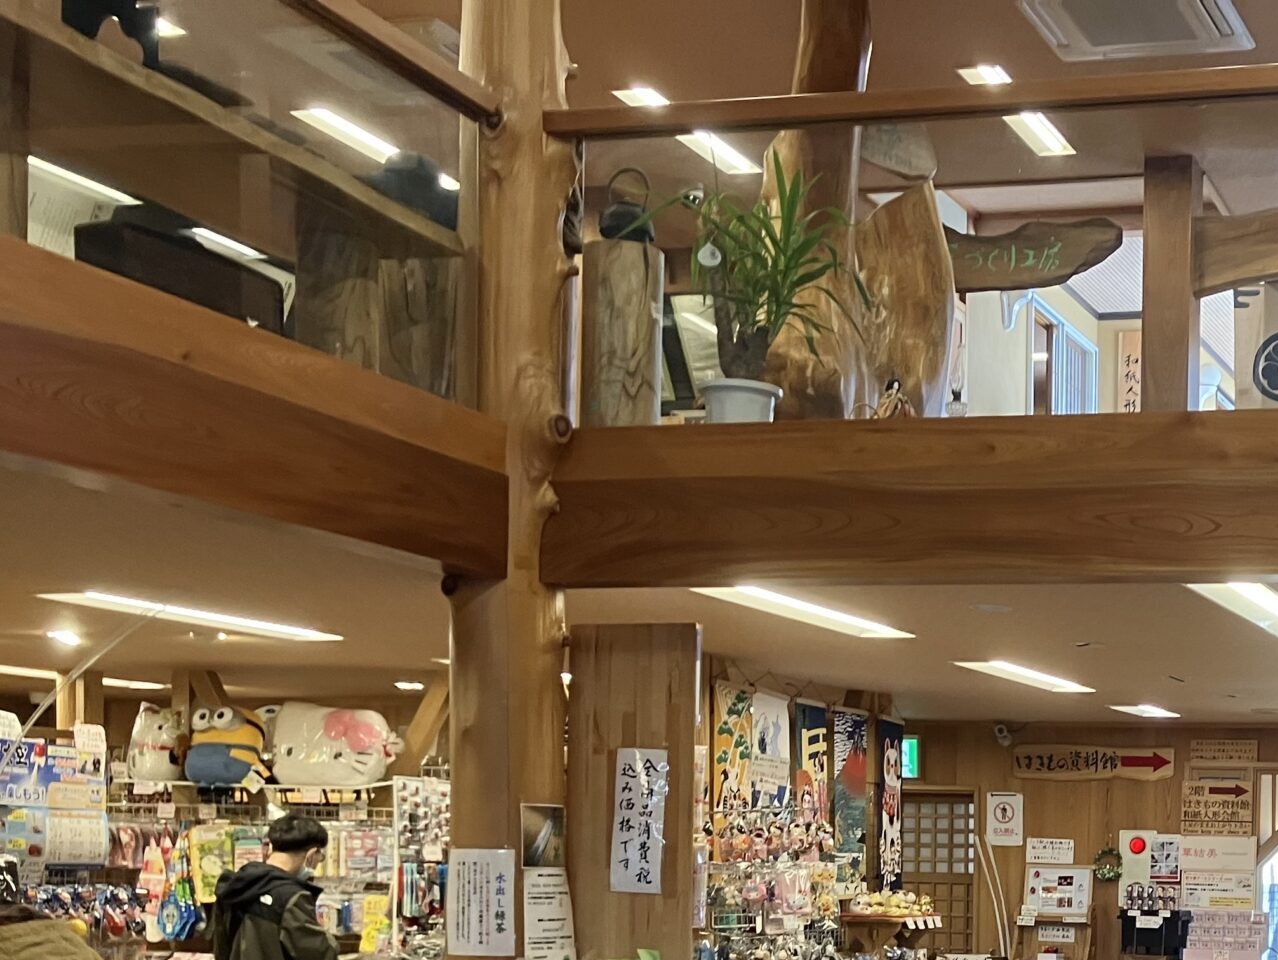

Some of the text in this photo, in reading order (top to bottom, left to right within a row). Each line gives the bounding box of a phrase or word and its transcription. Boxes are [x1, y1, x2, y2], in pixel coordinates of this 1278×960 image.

[1124, 354, 1140, 413] 和紙人形
[1016, 750, 1120, 773] はきもの資料館
[1188, 786, 1205, 797] 2階
[1183, 800, 1249, 810] はきもの資料館
[495, 872, 507, 934] 水出し緑茶
